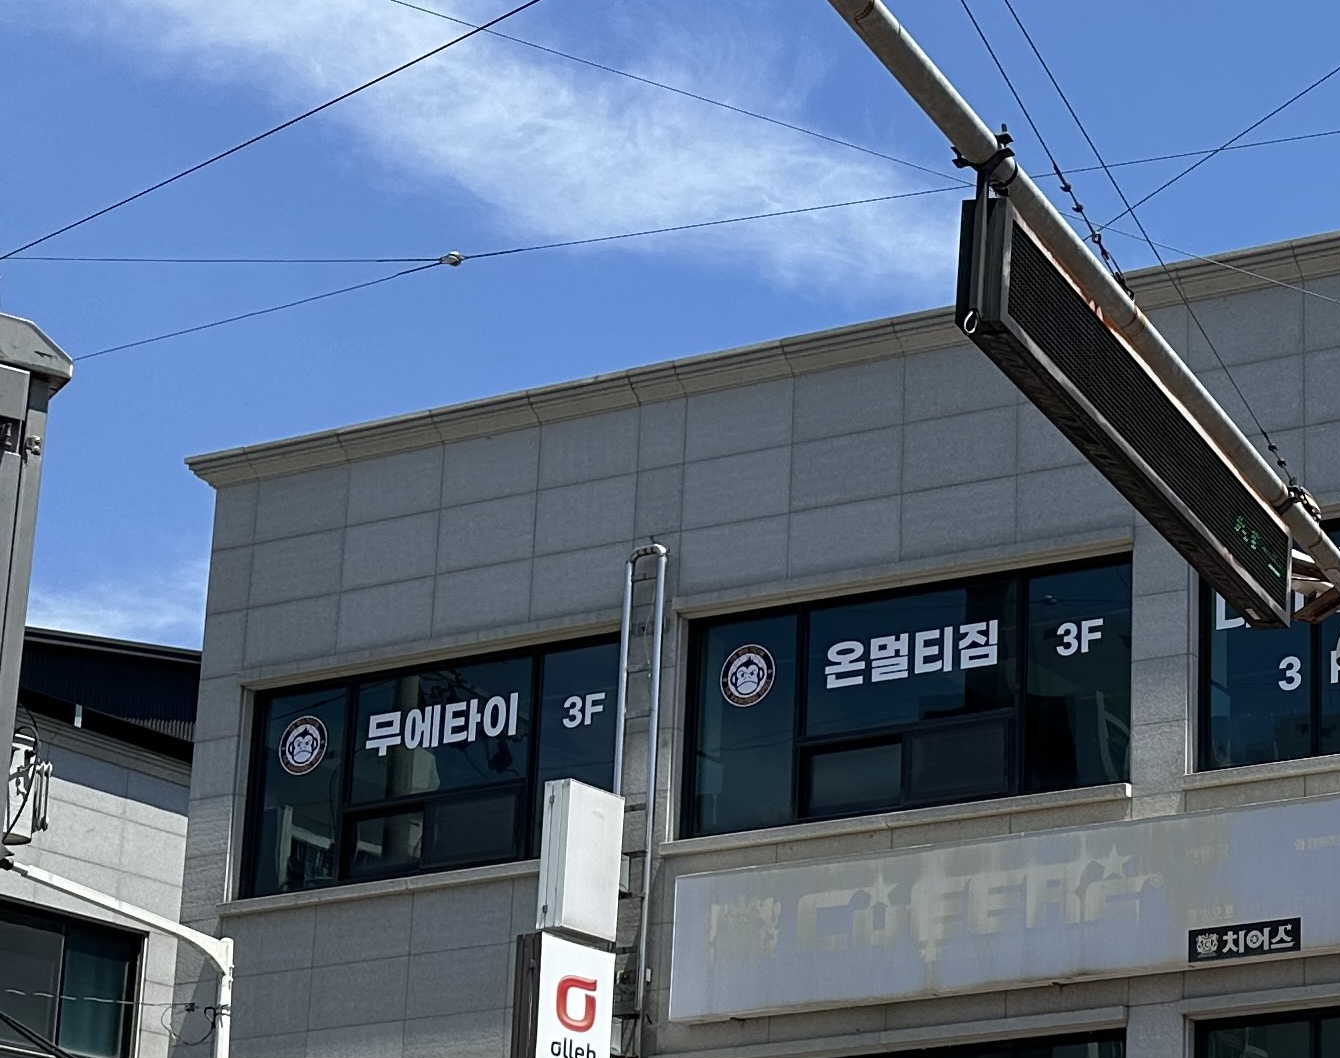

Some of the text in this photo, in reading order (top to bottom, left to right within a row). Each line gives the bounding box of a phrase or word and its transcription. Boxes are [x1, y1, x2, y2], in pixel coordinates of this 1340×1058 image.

[825, 620, 998, 689] 온멀티짐
[1056, 619, 1103, 656] 3F
[365, 691, 518, 756] 무에타이
[562, 691, 605, 729] 3F
[1222, 924, 1296, 953] 치어스
